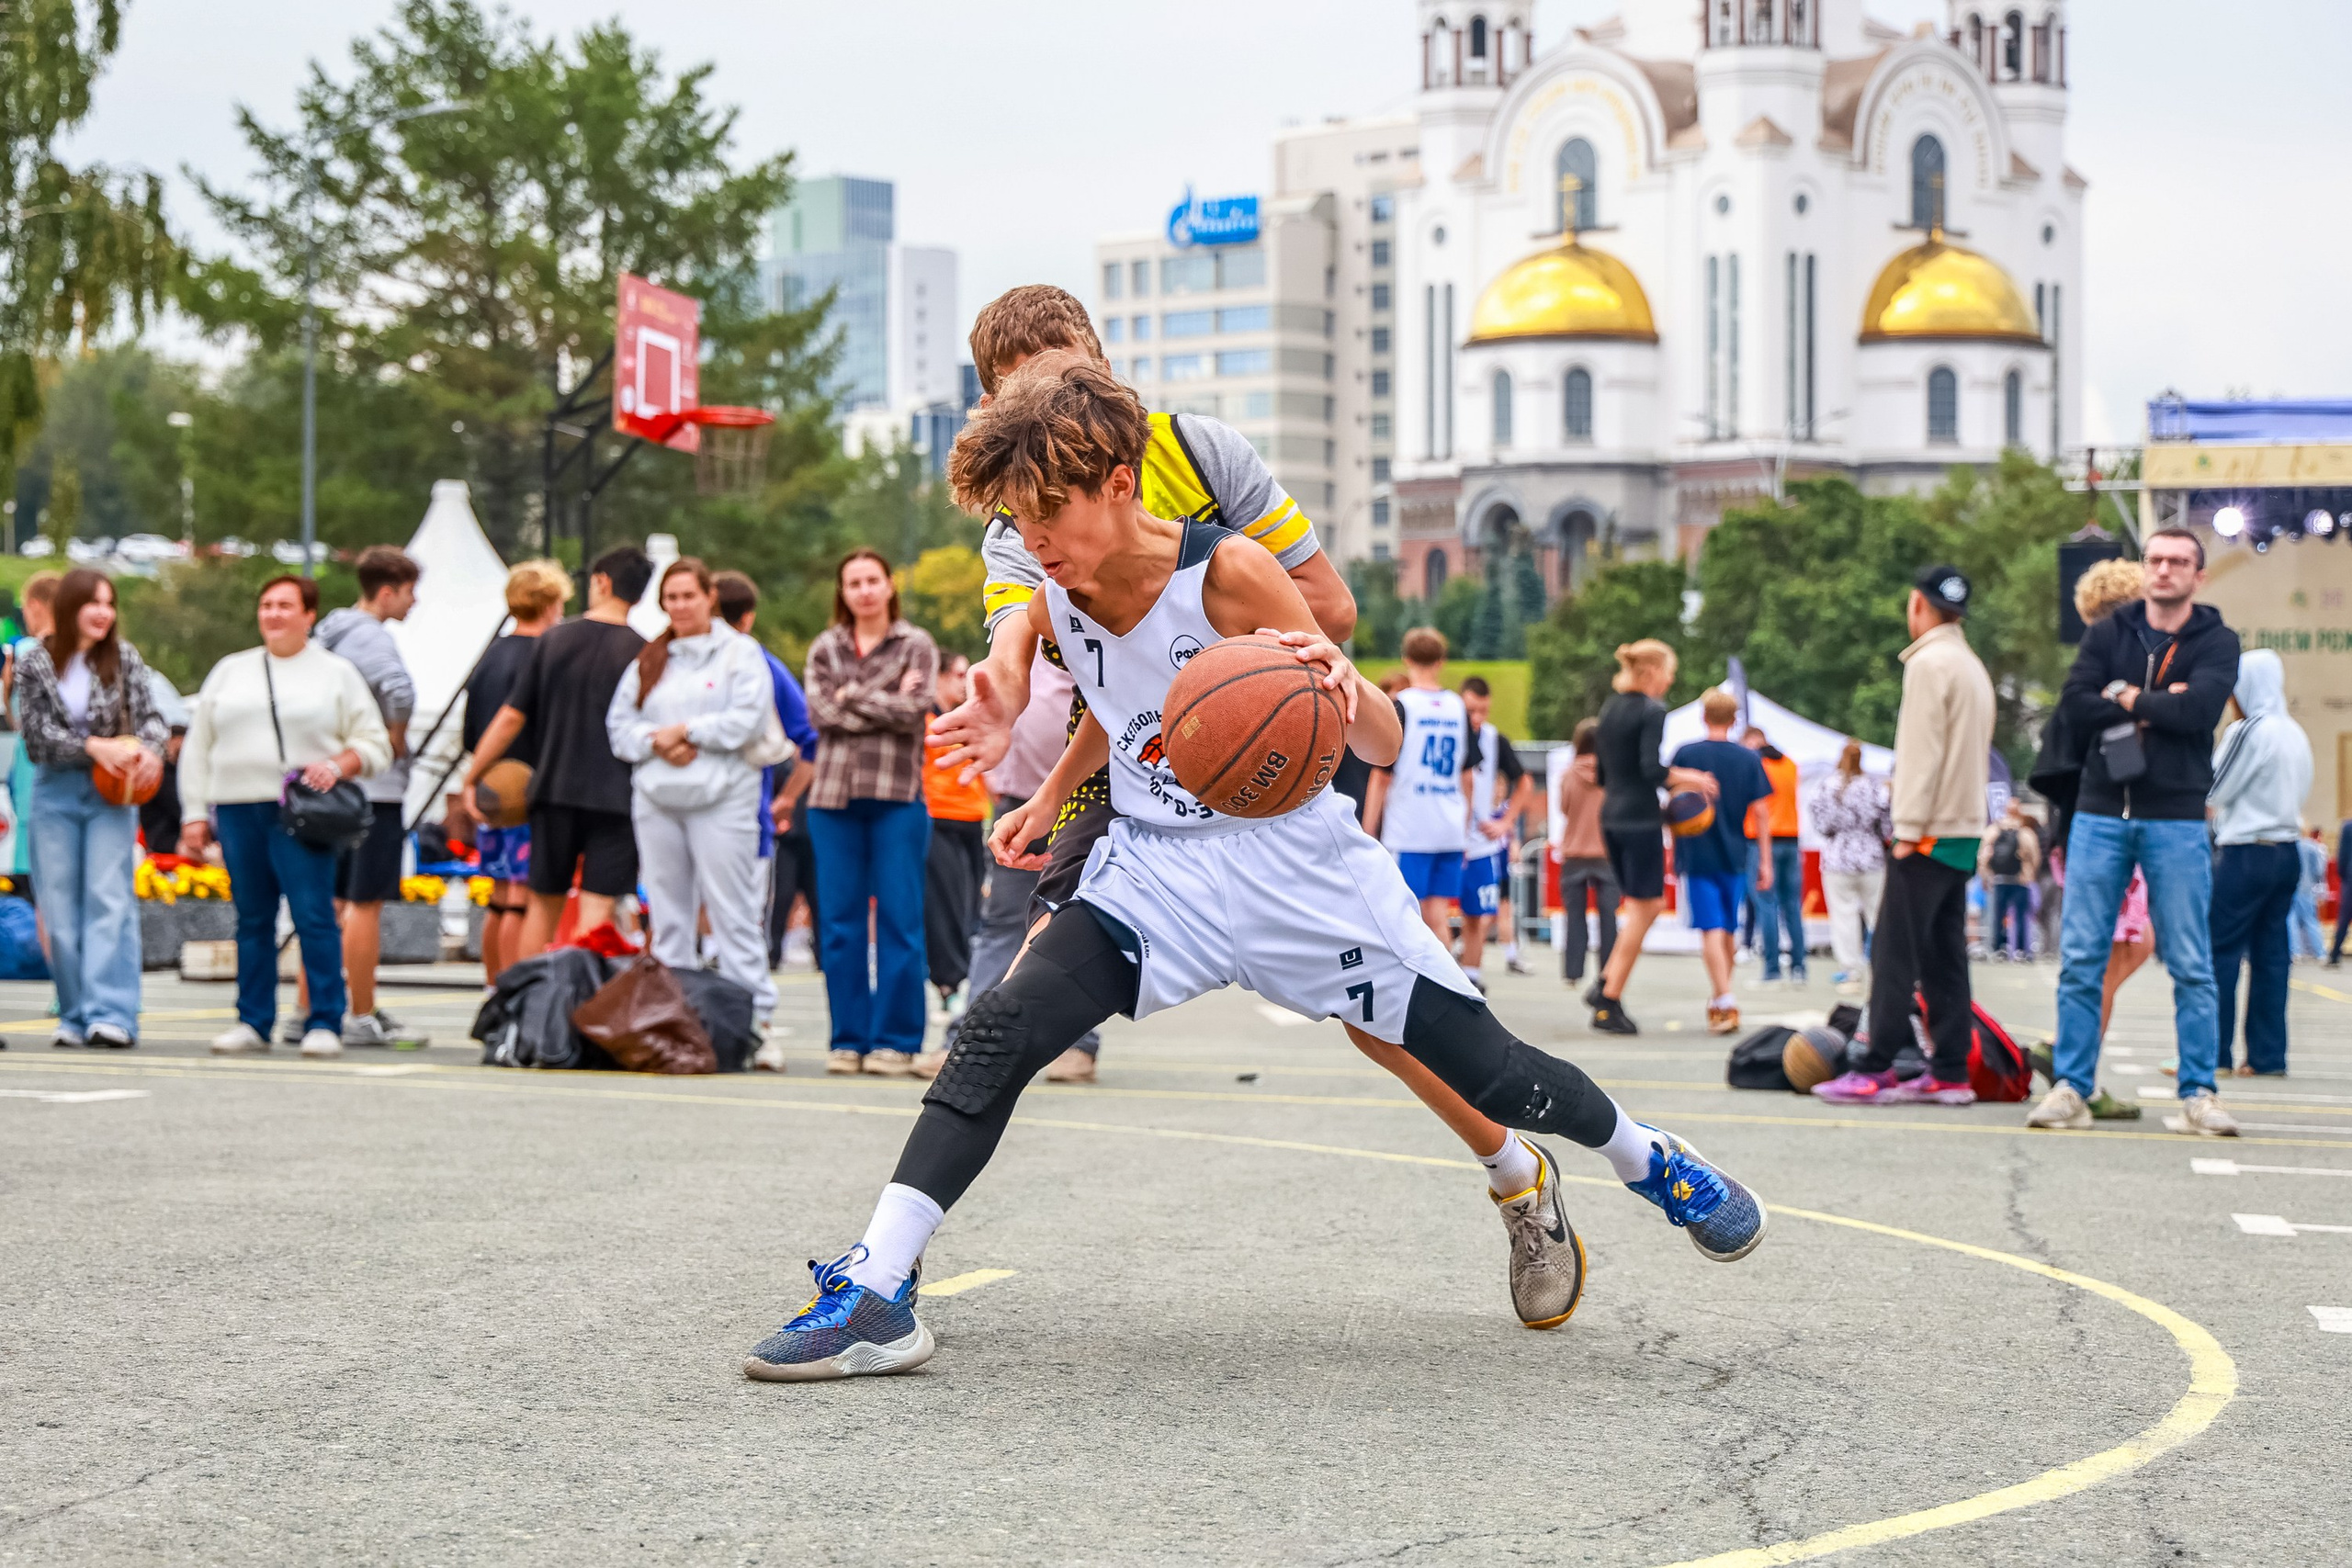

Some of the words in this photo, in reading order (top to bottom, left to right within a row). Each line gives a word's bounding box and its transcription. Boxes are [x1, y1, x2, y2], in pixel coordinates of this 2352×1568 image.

[1084, 638, 1104, 687] 7
[1250, 749, 1290, 790] BM
[1421, 735, 1455, 777] 48
[1345, 980, 1374, 1022] 7
